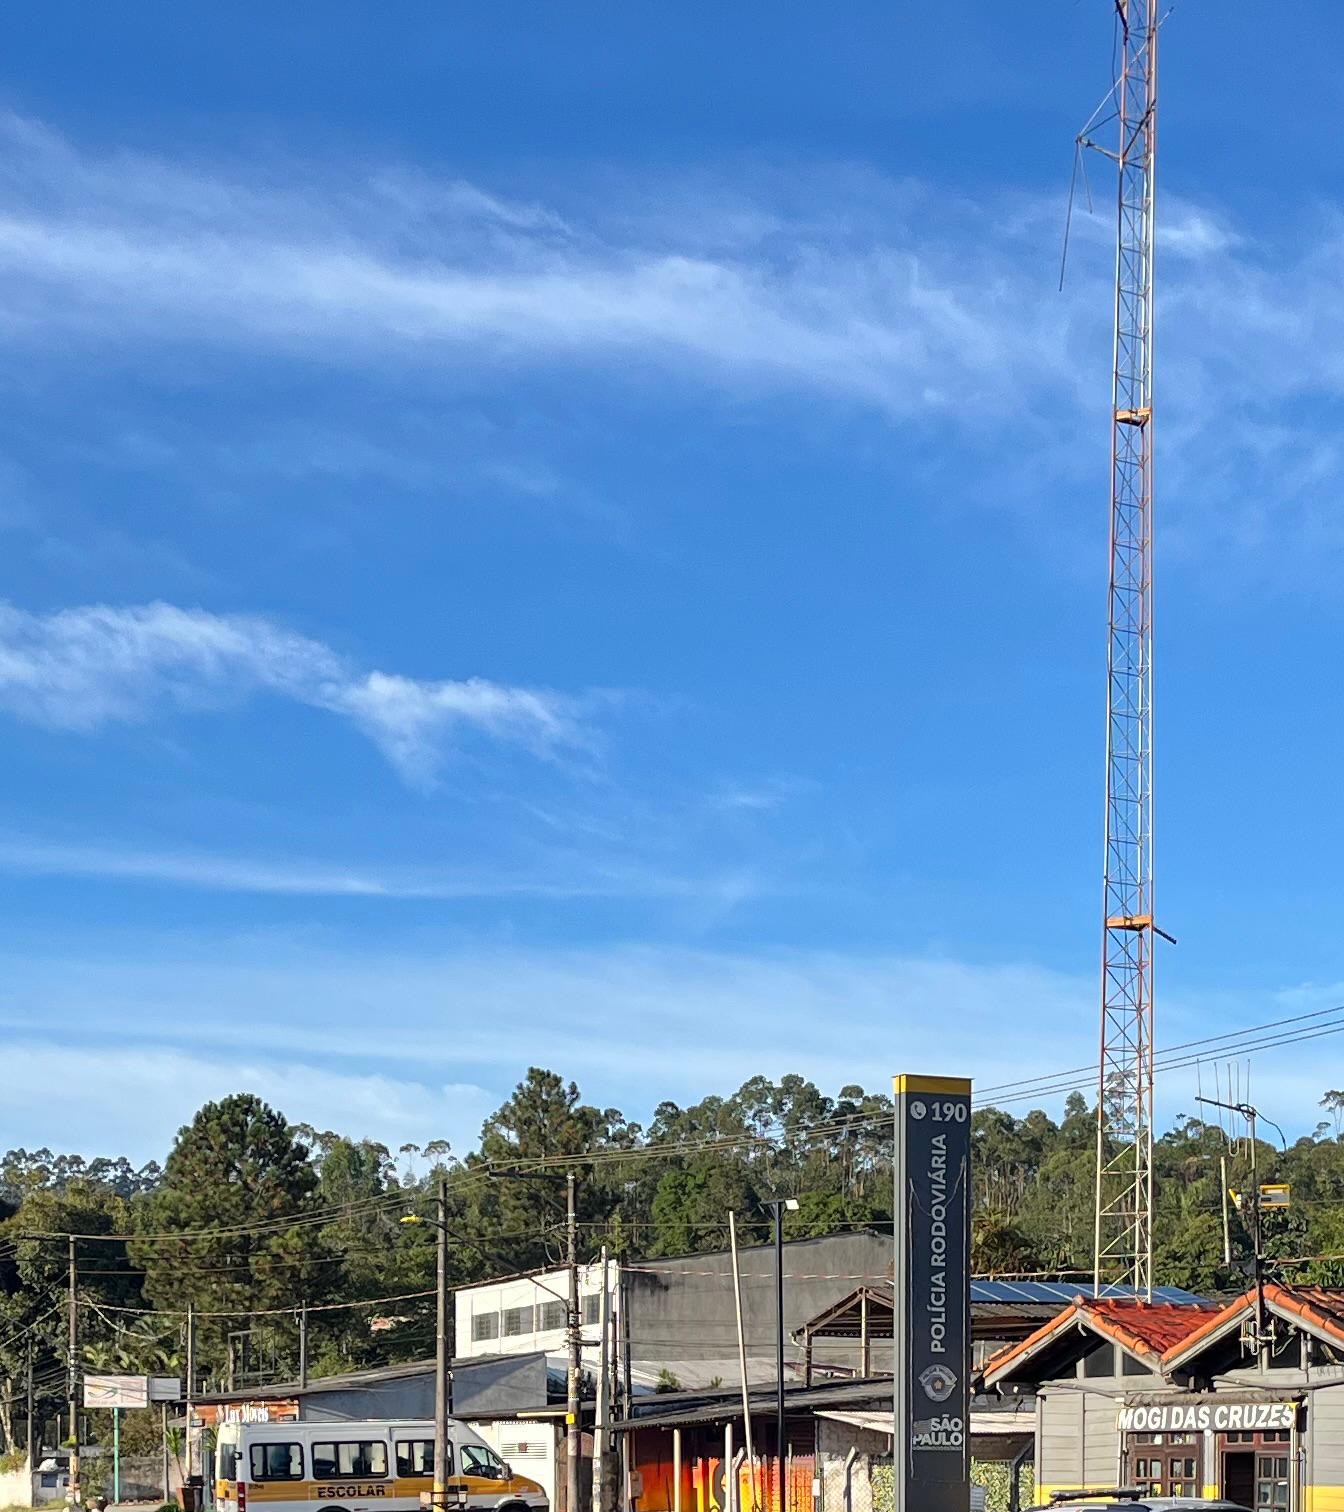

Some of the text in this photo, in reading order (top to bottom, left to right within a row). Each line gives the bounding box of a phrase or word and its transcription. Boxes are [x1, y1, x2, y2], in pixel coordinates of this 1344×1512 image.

[931, 1102, 967, 1123] 190
[927, 1133, 946, 1267] RODOVIÁRIA
[927, 1271, 946, 1353] POLÍCIA
[930, 1413, 963, 1432] SÃO
[1118, 1404, 1295, 1430] MOGI DAS CRUZES
[912, 1431, 963, 1446] PAULO
[317, 1485, 385, 1498] ESCOLAR
